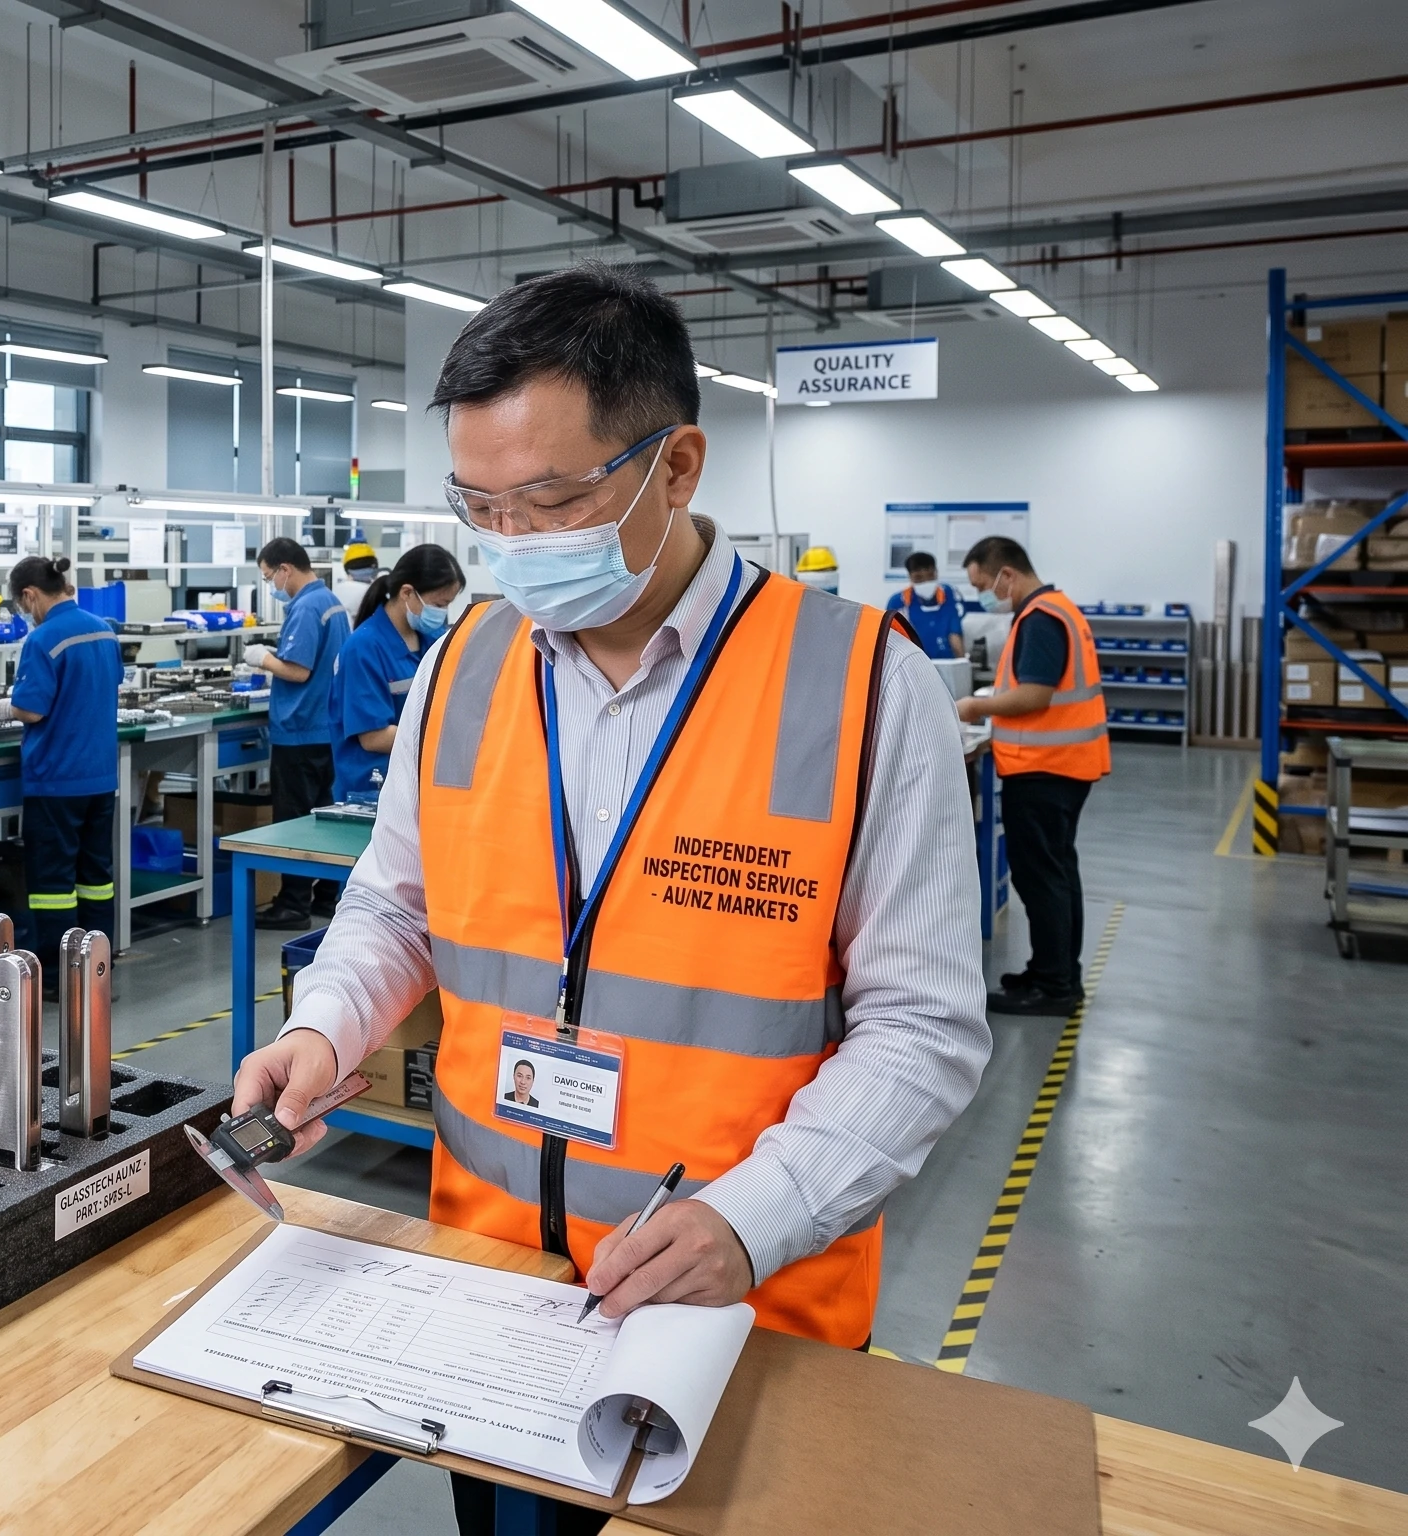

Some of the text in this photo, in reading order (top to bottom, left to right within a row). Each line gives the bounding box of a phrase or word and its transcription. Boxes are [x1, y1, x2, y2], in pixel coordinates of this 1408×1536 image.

[814, 353, 894, 375] QUALITY
[798, 374, 911, 394] ASSURANCE
[673, 835, 792, 869] INDEPENDENT
[643, 857, 819, 900] INSPECTION SERVICE
[662, 885, 714, 911] AU/NZ
[717, 893, 799, 923] MARKETS
[60, 1173, 114, 1211] GLASSTECH
